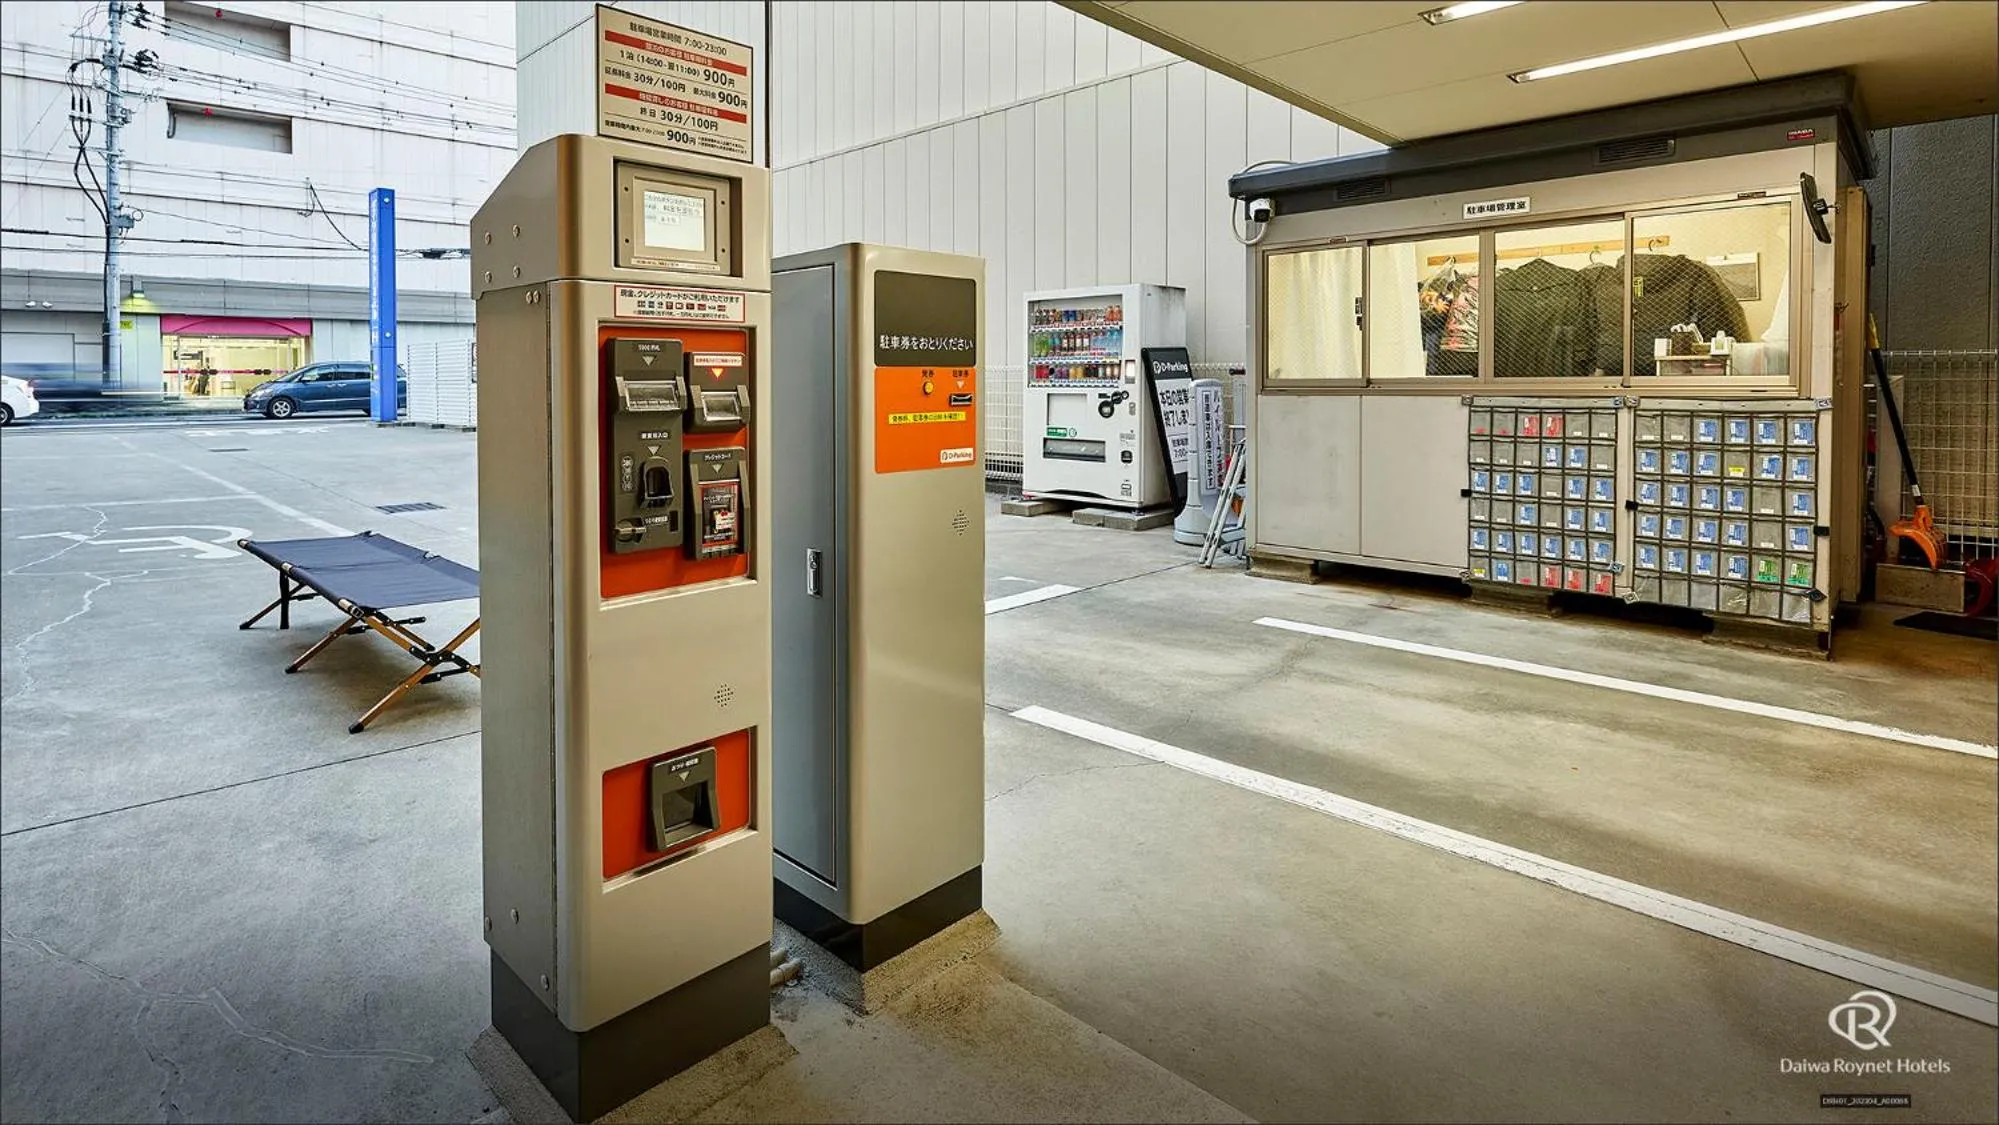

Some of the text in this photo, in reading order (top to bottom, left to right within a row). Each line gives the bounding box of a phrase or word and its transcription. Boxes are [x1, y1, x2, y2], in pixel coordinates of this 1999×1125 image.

[684, 37, 727, 56] 7:00-23:00
[703, 68, 735, 88] 900円
[633, 72, 686, 92] 30分/100円
[718, 91, 748, 109] 900円
[660, 110, 718, 131] 30分/100円
[666, 129, 697, 146] 900円
[1467, 200, 1526, 215] 駐車場管理室
[879, 335, 974, 351] 駐車券をおとりください
[1160, 388, 1189, 406] 本日の営業
[1163, 409, 1189, 427] 終了しま
